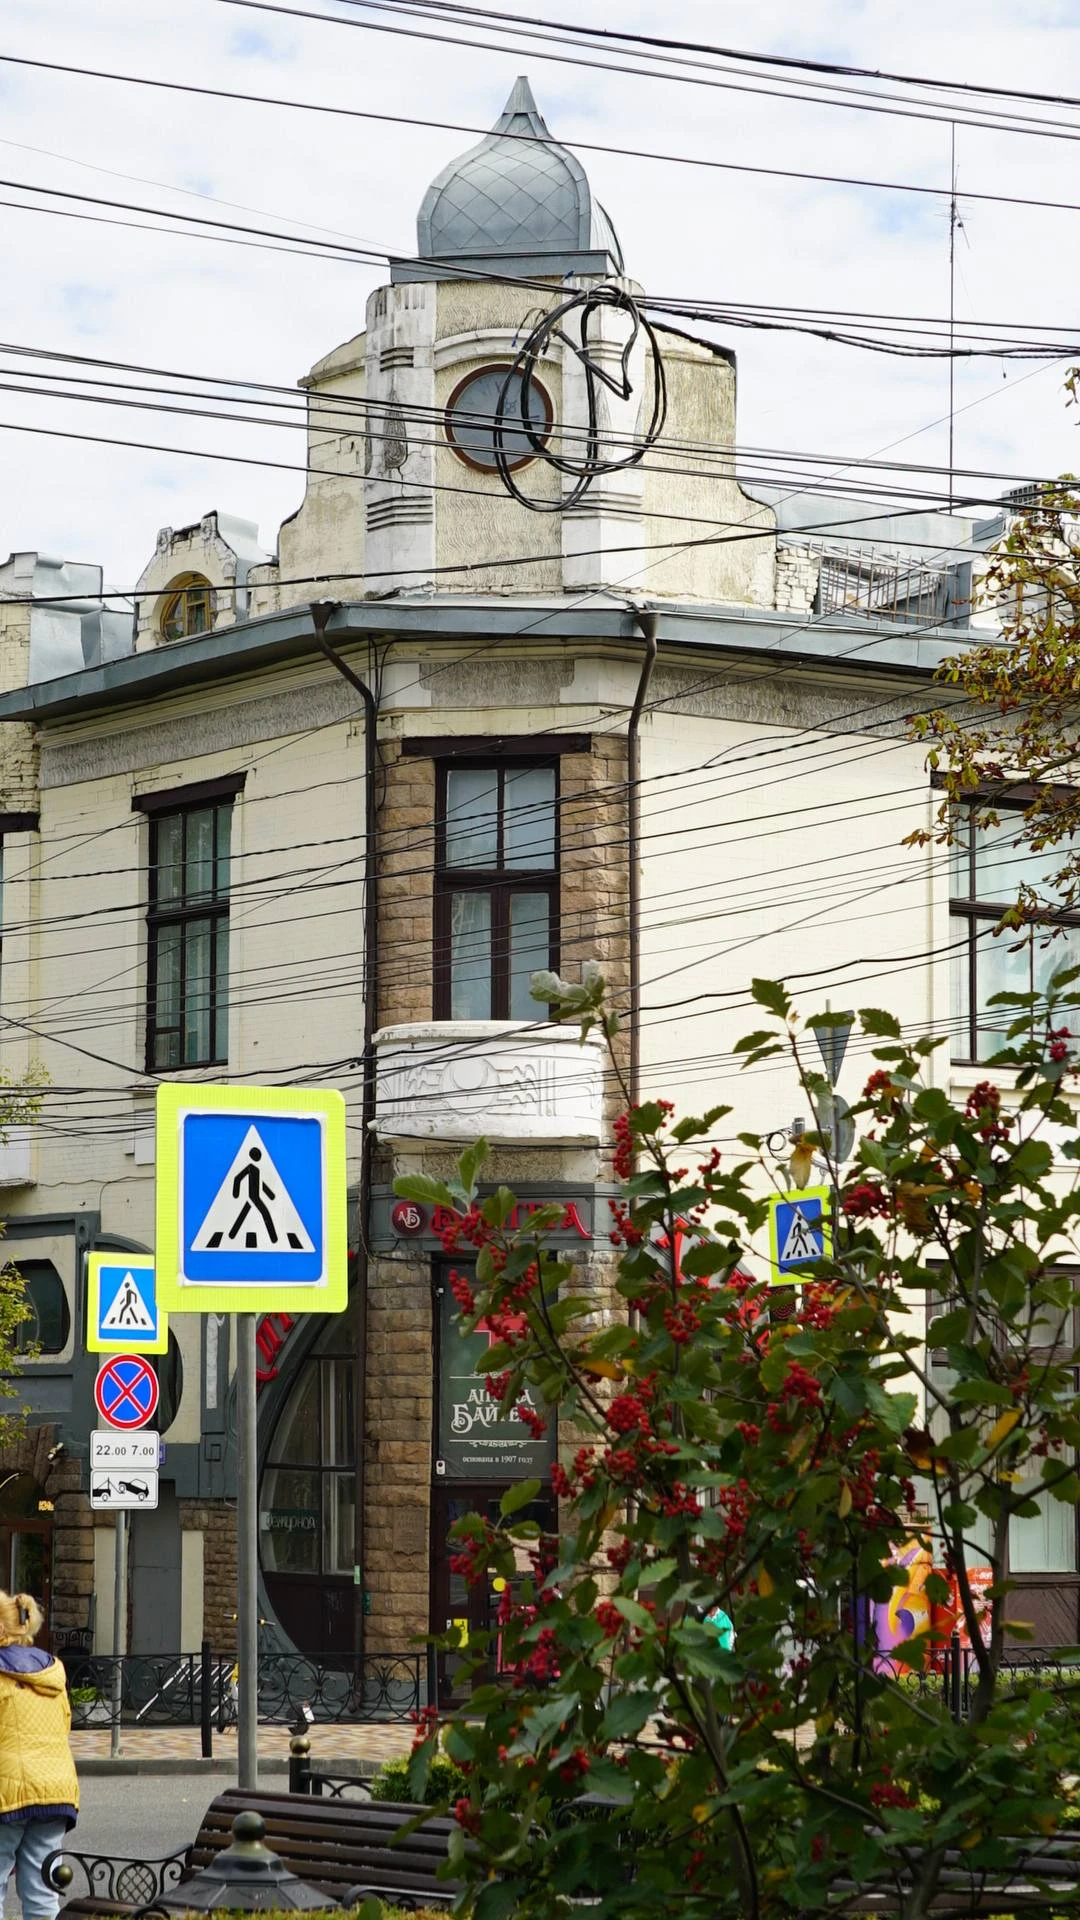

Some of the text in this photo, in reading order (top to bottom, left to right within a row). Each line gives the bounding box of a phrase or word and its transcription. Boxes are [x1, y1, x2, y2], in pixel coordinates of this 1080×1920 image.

[95, 1444, 155, 1456] 22.00 7.00
[500, 1455, 517, 1463] 1907
[518, 1457, 534, 1465] году
